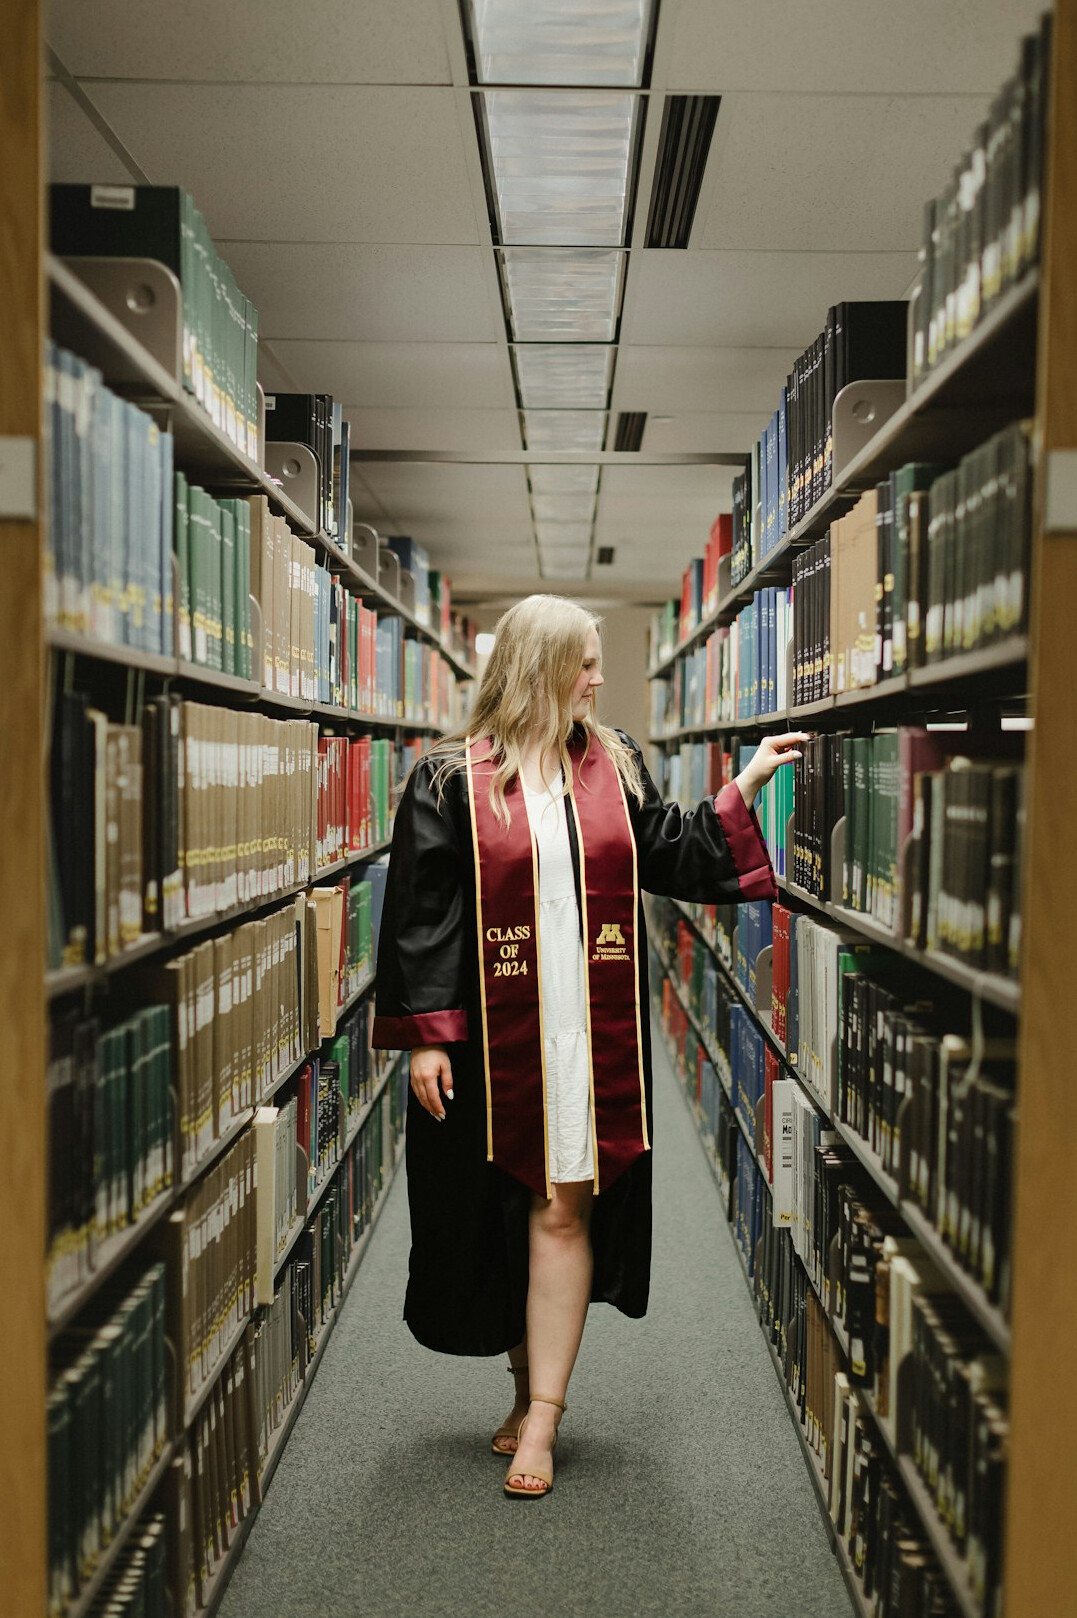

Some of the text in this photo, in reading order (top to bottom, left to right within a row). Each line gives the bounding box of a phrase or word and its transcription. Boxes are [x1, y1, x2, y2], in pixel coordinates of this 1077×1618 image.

[486, 926, 531, 942] CLASS
[499, 944, 519, 960] OF
[493, 960, 528, 977] 2024
